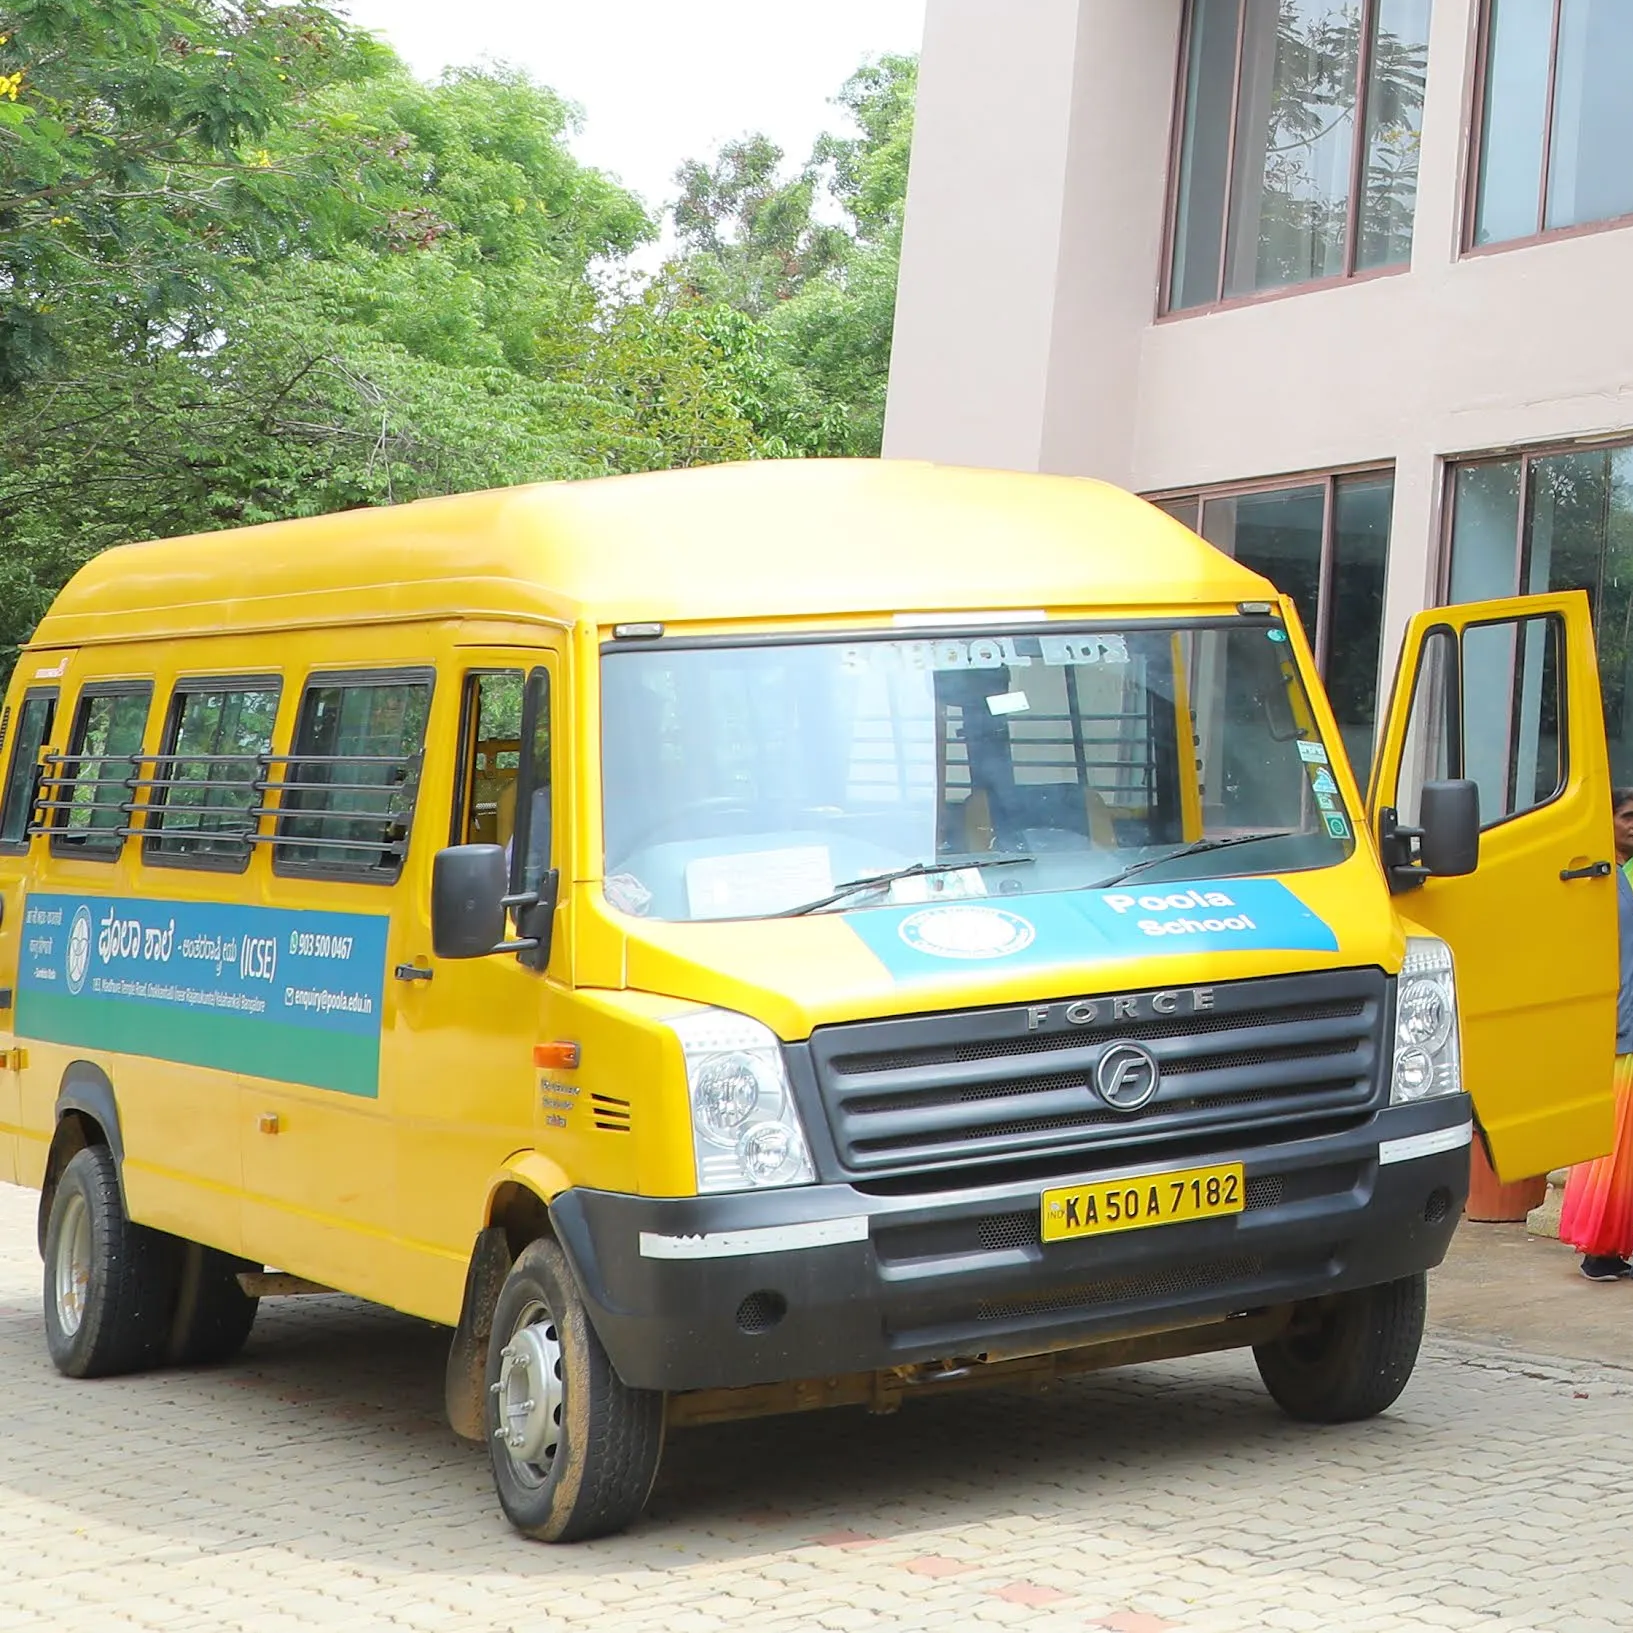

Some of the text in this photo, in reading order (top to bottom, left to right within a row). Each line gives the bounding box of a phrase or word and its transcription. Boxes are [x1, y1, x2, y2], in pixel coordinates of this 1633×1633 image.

[1102, 888, 1236, 915] Poola
[1136, 914, 1257, 937] School
[240, 934, 277, 983] (ICSE)
[298, 933, 353, 960] 903 500 0467
[295, 987, 372, 1014] enquiry@poola.edu.in
[1027, 987, 1215, 1030] FORCE
